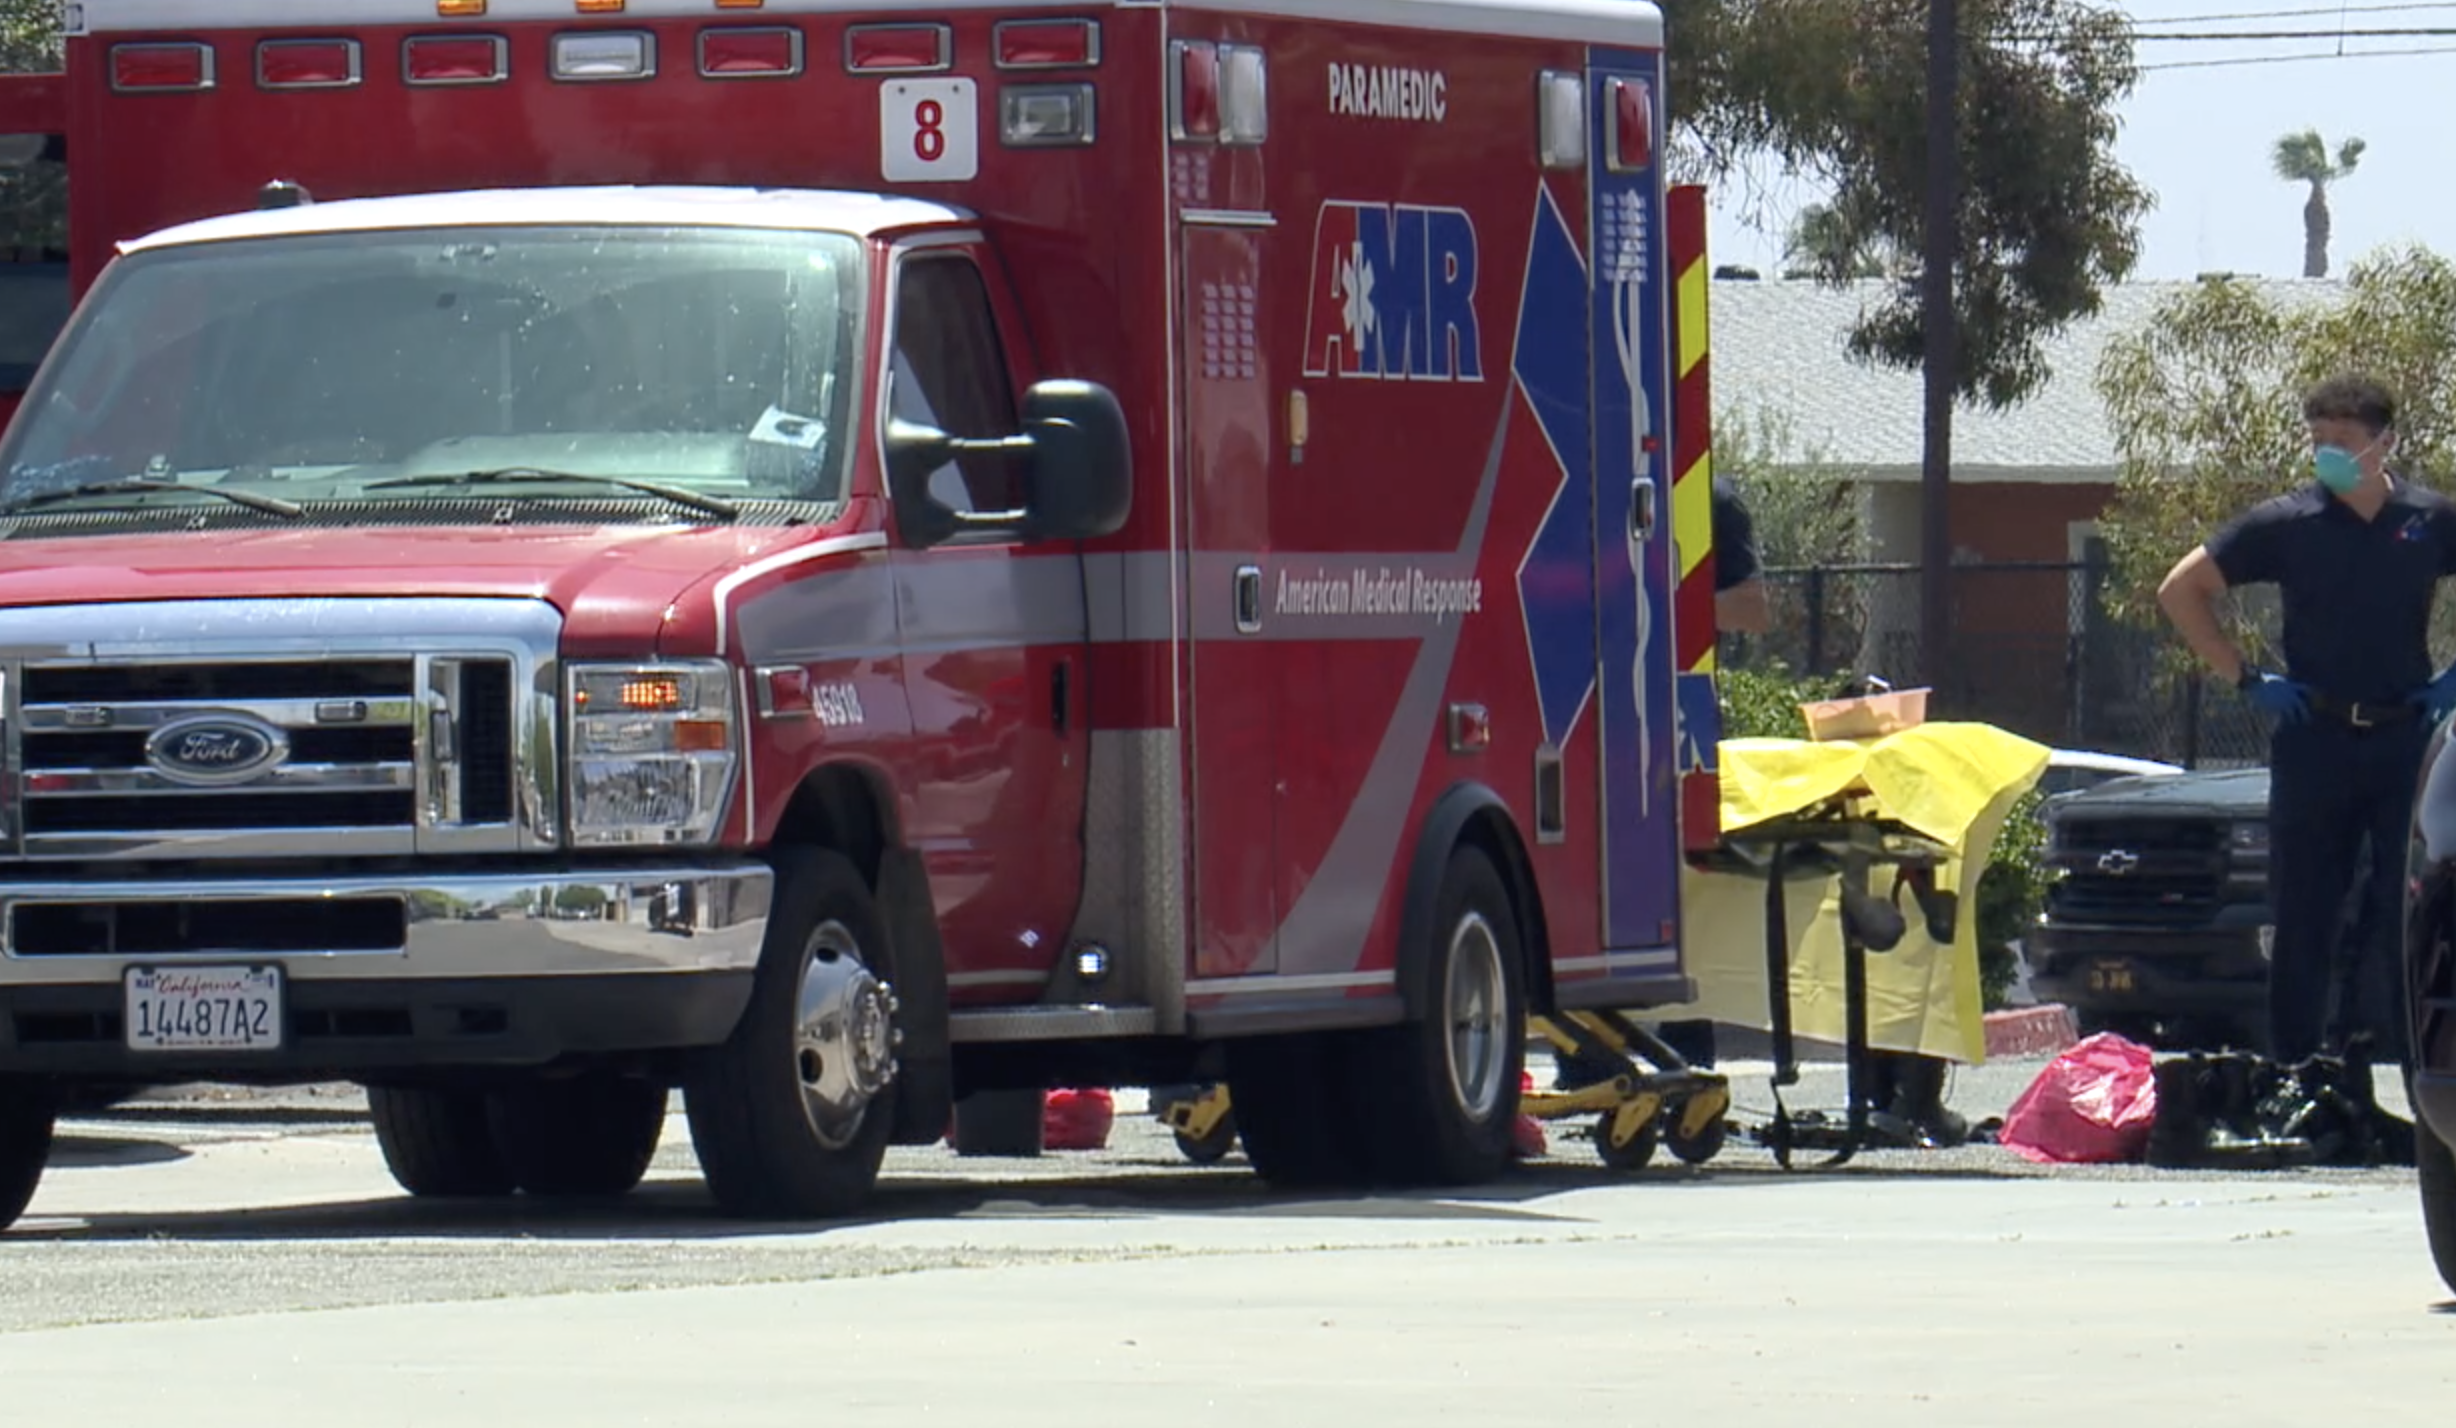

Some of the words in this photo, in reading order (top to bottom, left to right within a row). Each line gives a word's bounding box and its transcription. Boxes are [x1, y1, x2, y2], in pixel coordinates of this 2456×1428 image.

[1328, 62, 1447, 122] PARAMEDIC
[914, 99, 945, 163] 8
[1303, 199, 1485, 382] AMR
[1275, 568, 1349, 615] American
[1351, 566, 1411, 614] Medical
[1412, 569, 1482, 625] Response
[180, 732, 241, 760] Ford
[158, 974, 250, 998] California
[137, 998, 269, 1037] 14487A2
